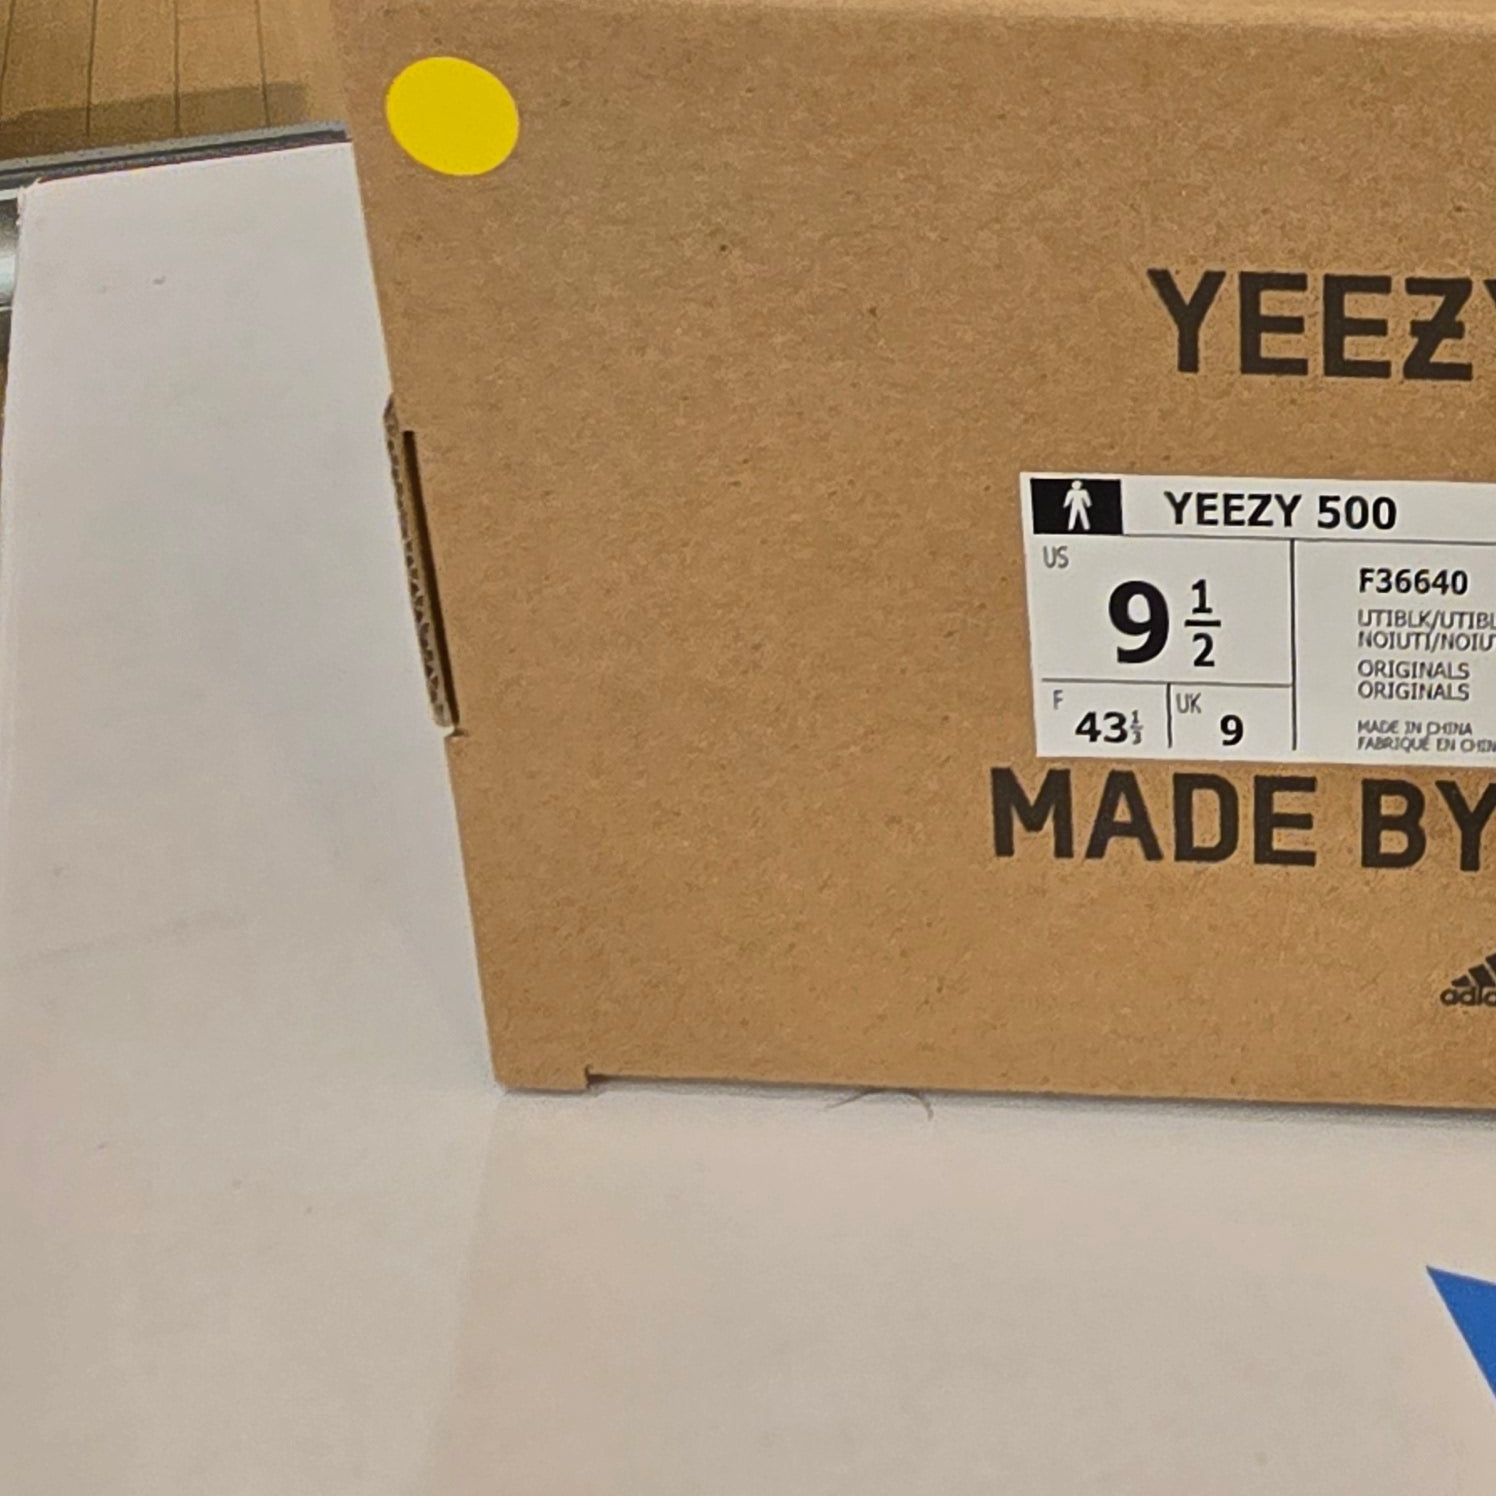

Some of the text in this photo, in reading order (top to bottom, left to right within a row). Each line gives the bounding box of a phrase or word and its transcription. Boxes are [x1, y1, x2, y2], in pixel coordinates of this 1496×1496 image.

[1164, 491, 1398, 530] YEEZY 500
[1043, 546, 1069, 569] US
[1359, 568, 1469, 595] F36640
[1108, 580, 1170, 664] 9
[1357, 659, 1470, 680] ORIGINALS
[1053, 690, 1064, 710] F
[1357, 681, 1470, 701] ORIGINALS
[1176, 693, 1202, 714] UK
[1220, 715, 1244, 747] 9
[1357, 720, 1472, 736] MADE IN CHINA
[990, 767, 1317, 867] MADE
